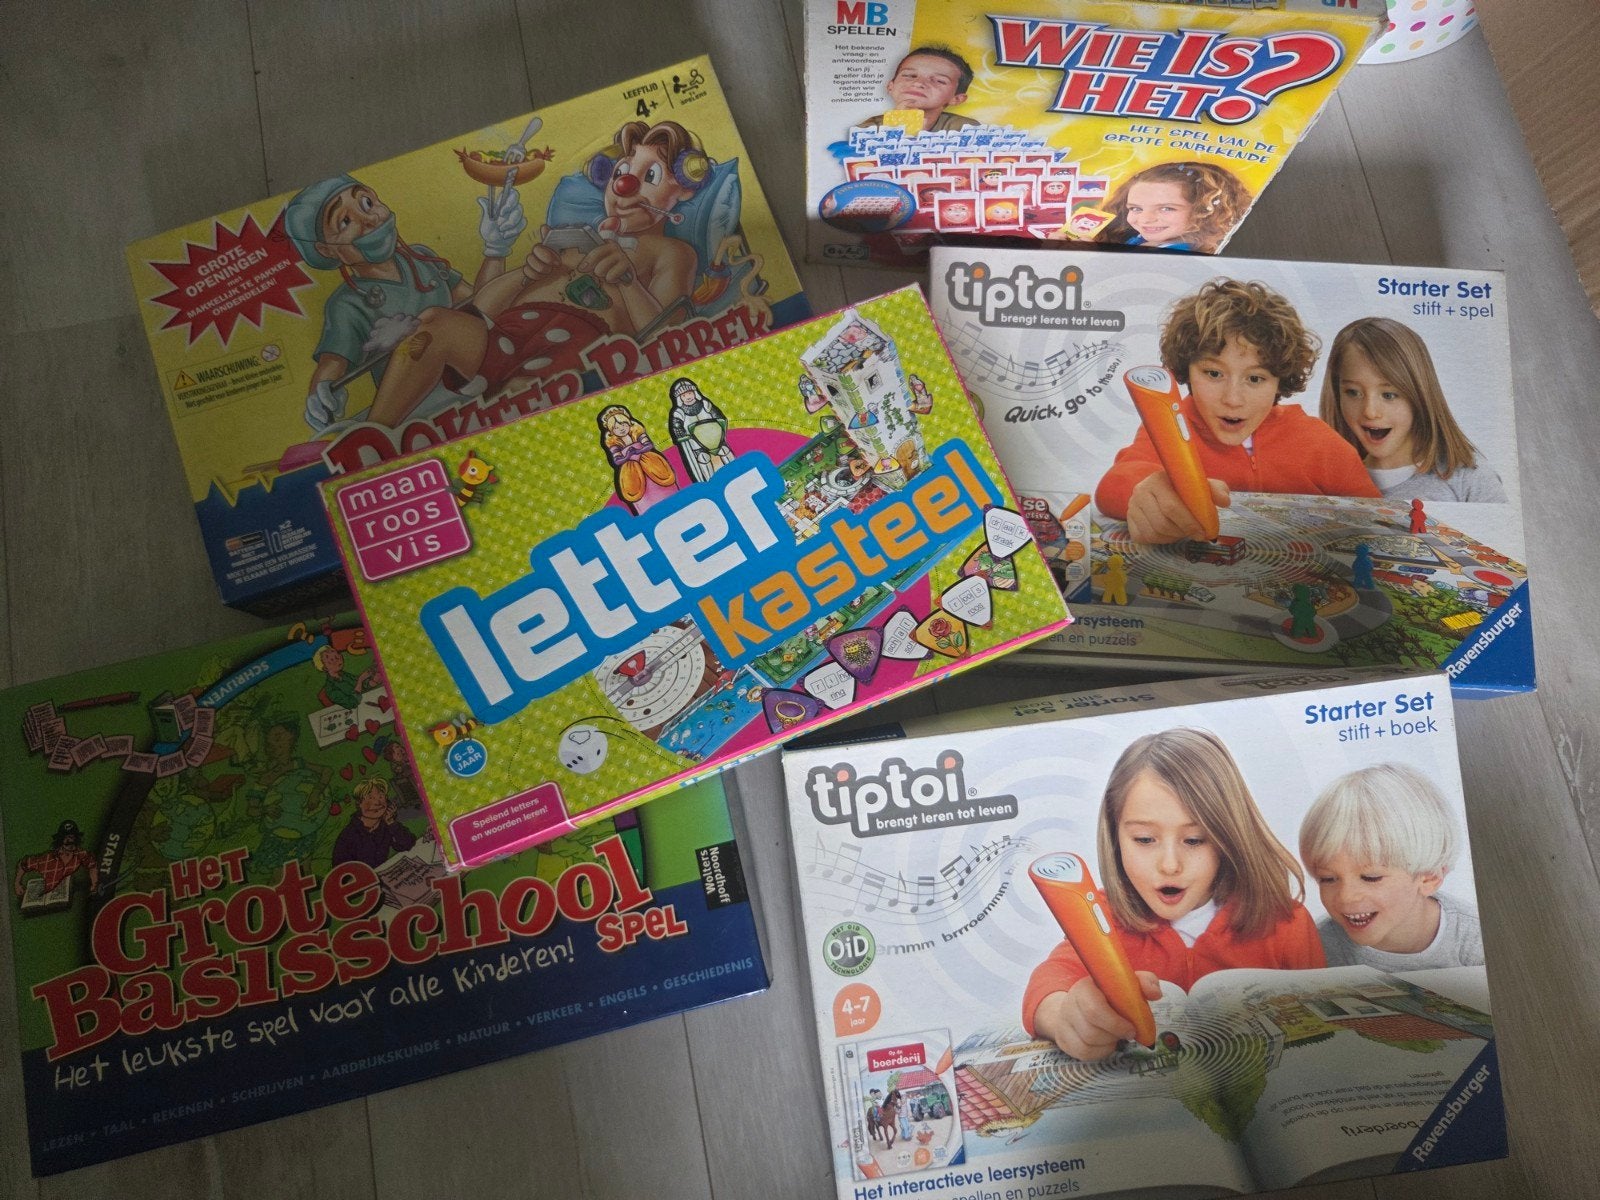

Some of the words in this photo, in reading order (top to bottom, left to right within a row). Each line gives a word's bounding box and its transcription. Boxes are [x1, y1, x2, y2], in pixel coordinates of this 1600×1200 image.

[837, 0, 888, 26] MB
[827, 25, 896, 36] SPELLEN
[996, 18, 1164, 71] WIE
[623, 82, 658, 100] LEEFTIJD
[1055, 68, 1222, 119] HET
[636, 98, 659, 118] 4+
[1104, 134, 1163, 146] GROTE
[1170, 140, 1270, 163] ONBEKENDE
[1129, 124, 1164, 135] HET
[1169, 128, 1210, 142] SPEL
[1218, 135, 1249, 148] VAN
[1254, 141, 1278, 153] DE
[185, 247, 269, 297] OPENINGEN
[198, 244, 246, 277] GROTE
[186, 287, 240, 320] MAKKELIJK
[240, 281, 254, 292] TE
[254, 258, 291, 284] PAKKEN
[227, 275, 243, 287] met
[951, 266, 1078, 323] tiptoi
[1378, 277, 1450, 298] Starter
[1457, 281, 1492, 299] Set
[212, 279, 277, 316] ONDERDELEN!
[1413, 301, 1442, 316] stift
[1460, 303, 1494, 320] spel
[1000, 312, 1037, 326] brengt
[1040, 314, 1068, 325] leren
[1071, 316, 1087, 325] tot
[1090, 316, 1120, 327] leven
[1003, 404, 1063, 424] Quick,
[1064, 394, 1088, 415] go
[1086, 383, 1103, 398] to
[1099, 371, 1114, 387] the
[350, 469, 437, 511] maan
[365, 500, 441, 538] roos
[386, 533, 441, 563] vis
[702, 449, 990, 659] kasteel
[992, 534, 1015, 547] draak
[439, 466, 778, 707] letter
[967, 603, 985, 616] roos
[1069, 635, 1084, 644] en
[1089, 633, 1137, 647] puzzels
[1445, 602, 1523, 679] Ravensburger
[201, 660, 270, 707] SCHRIJVEN
[1014, 706, 1058, 717] Set
[1065, 693, 1155, 711] Starter
[1305, 700, 1387, 725] Starter
[1395, 691, 1434, 714] Set
[1338, 722, 1370, 742] stift
[1390, 715, 1438, 737] boek
[457, 752, 483, 772] JAAR
[813, 756, 961, 832] tiptoi
[471, 831, 483, 843] en
[483, 817, 523, 836] woorden
[523, 804, 548, 822] leren!
[472, 808, 510, 829] Spelend
[510, 797, 540, 815] letters
[876, 812, 919, 831] brengt
[921, 808, 954, 825] leren
[957, 806, 977, 821] tot
[978, 801, 1013, 817] leven
[99, 832, 121, 875] START
[700, 849, 716, 895] Wolters
[709, 846, 731, 903] Noordhoff
[92, 860, 382, 975] Grote
[32, 834, 653, 1062] Basisschool
[828, 935, 869, 961] OiD
[830, 957, 872, 975] TECHNOLOGIE
[842, 995, 870, 1015] 4-7
[55, 1054, 110, 1091] Het
[247, 1008, 300, 1045] spel
[310, 986, 377, 1024] voor
[389, 973, 444, 1006] alle
[850, 1016, 866, 1028] jaar
[42, 1133, 85, 1152] LEZEN
[102, 1120, 136, 1137] TAAL
[152, 1098, 214, 1123] REKENEN
[231, 1076, 304, 1103] SCHRIJVEN
[321, 1039, 441, 1081] AARDRIJKSKUNDE
[456, 1021, 511, 1045] NATUUR
[526, 1001, 583, 1026] VERKEER
[599, 984, 648, 1009] ENGELS
[662, 956, 754, 990] GESCHIEDENIS
[872, 1052, 921, 1070] boerderij
[1341, 1120, 1420, 1137] boerderij
[1412, 1064, 1490, 1163] Ravensburger
[854, 1185, 884, 1200] Het
[888, 1171, 984, 1197] interactieve
[988, 1158, 1085, 1181] leersysteem
[1006, 1187, 1024, 1200] en
[1028, 1179, 1080, 1200] puzzels
